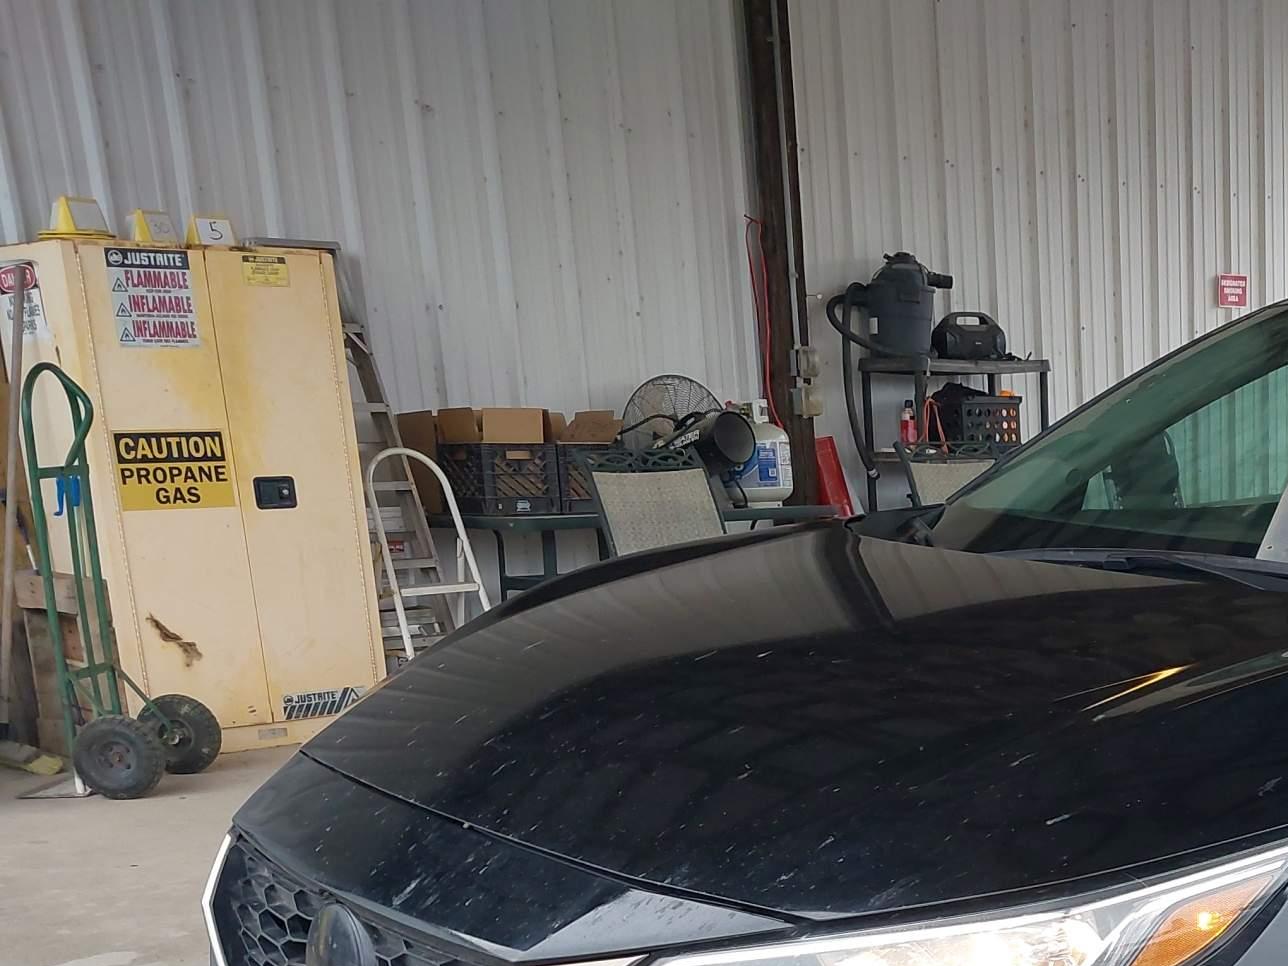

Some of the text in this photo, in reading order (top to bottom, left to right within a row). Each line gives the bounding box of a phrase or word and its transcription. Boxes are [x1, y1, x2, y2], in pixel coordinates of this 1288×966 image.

[209, 221, 223, 240] 5
[124, 252, 182, 267] JUSTRITE
[124, 269, 189, 289] FLAMMABLE
[128, 294, 193, 314] INFLAMABLE
[132, 319, 197, 339] INFLAMMABLE
[119, 435, 222, 460] CAUTION
[120, 465, 229, 485] PROPANE
[155, 486, 201, 505] GAS
[294, 690, 338, 704] JUSTRITE
